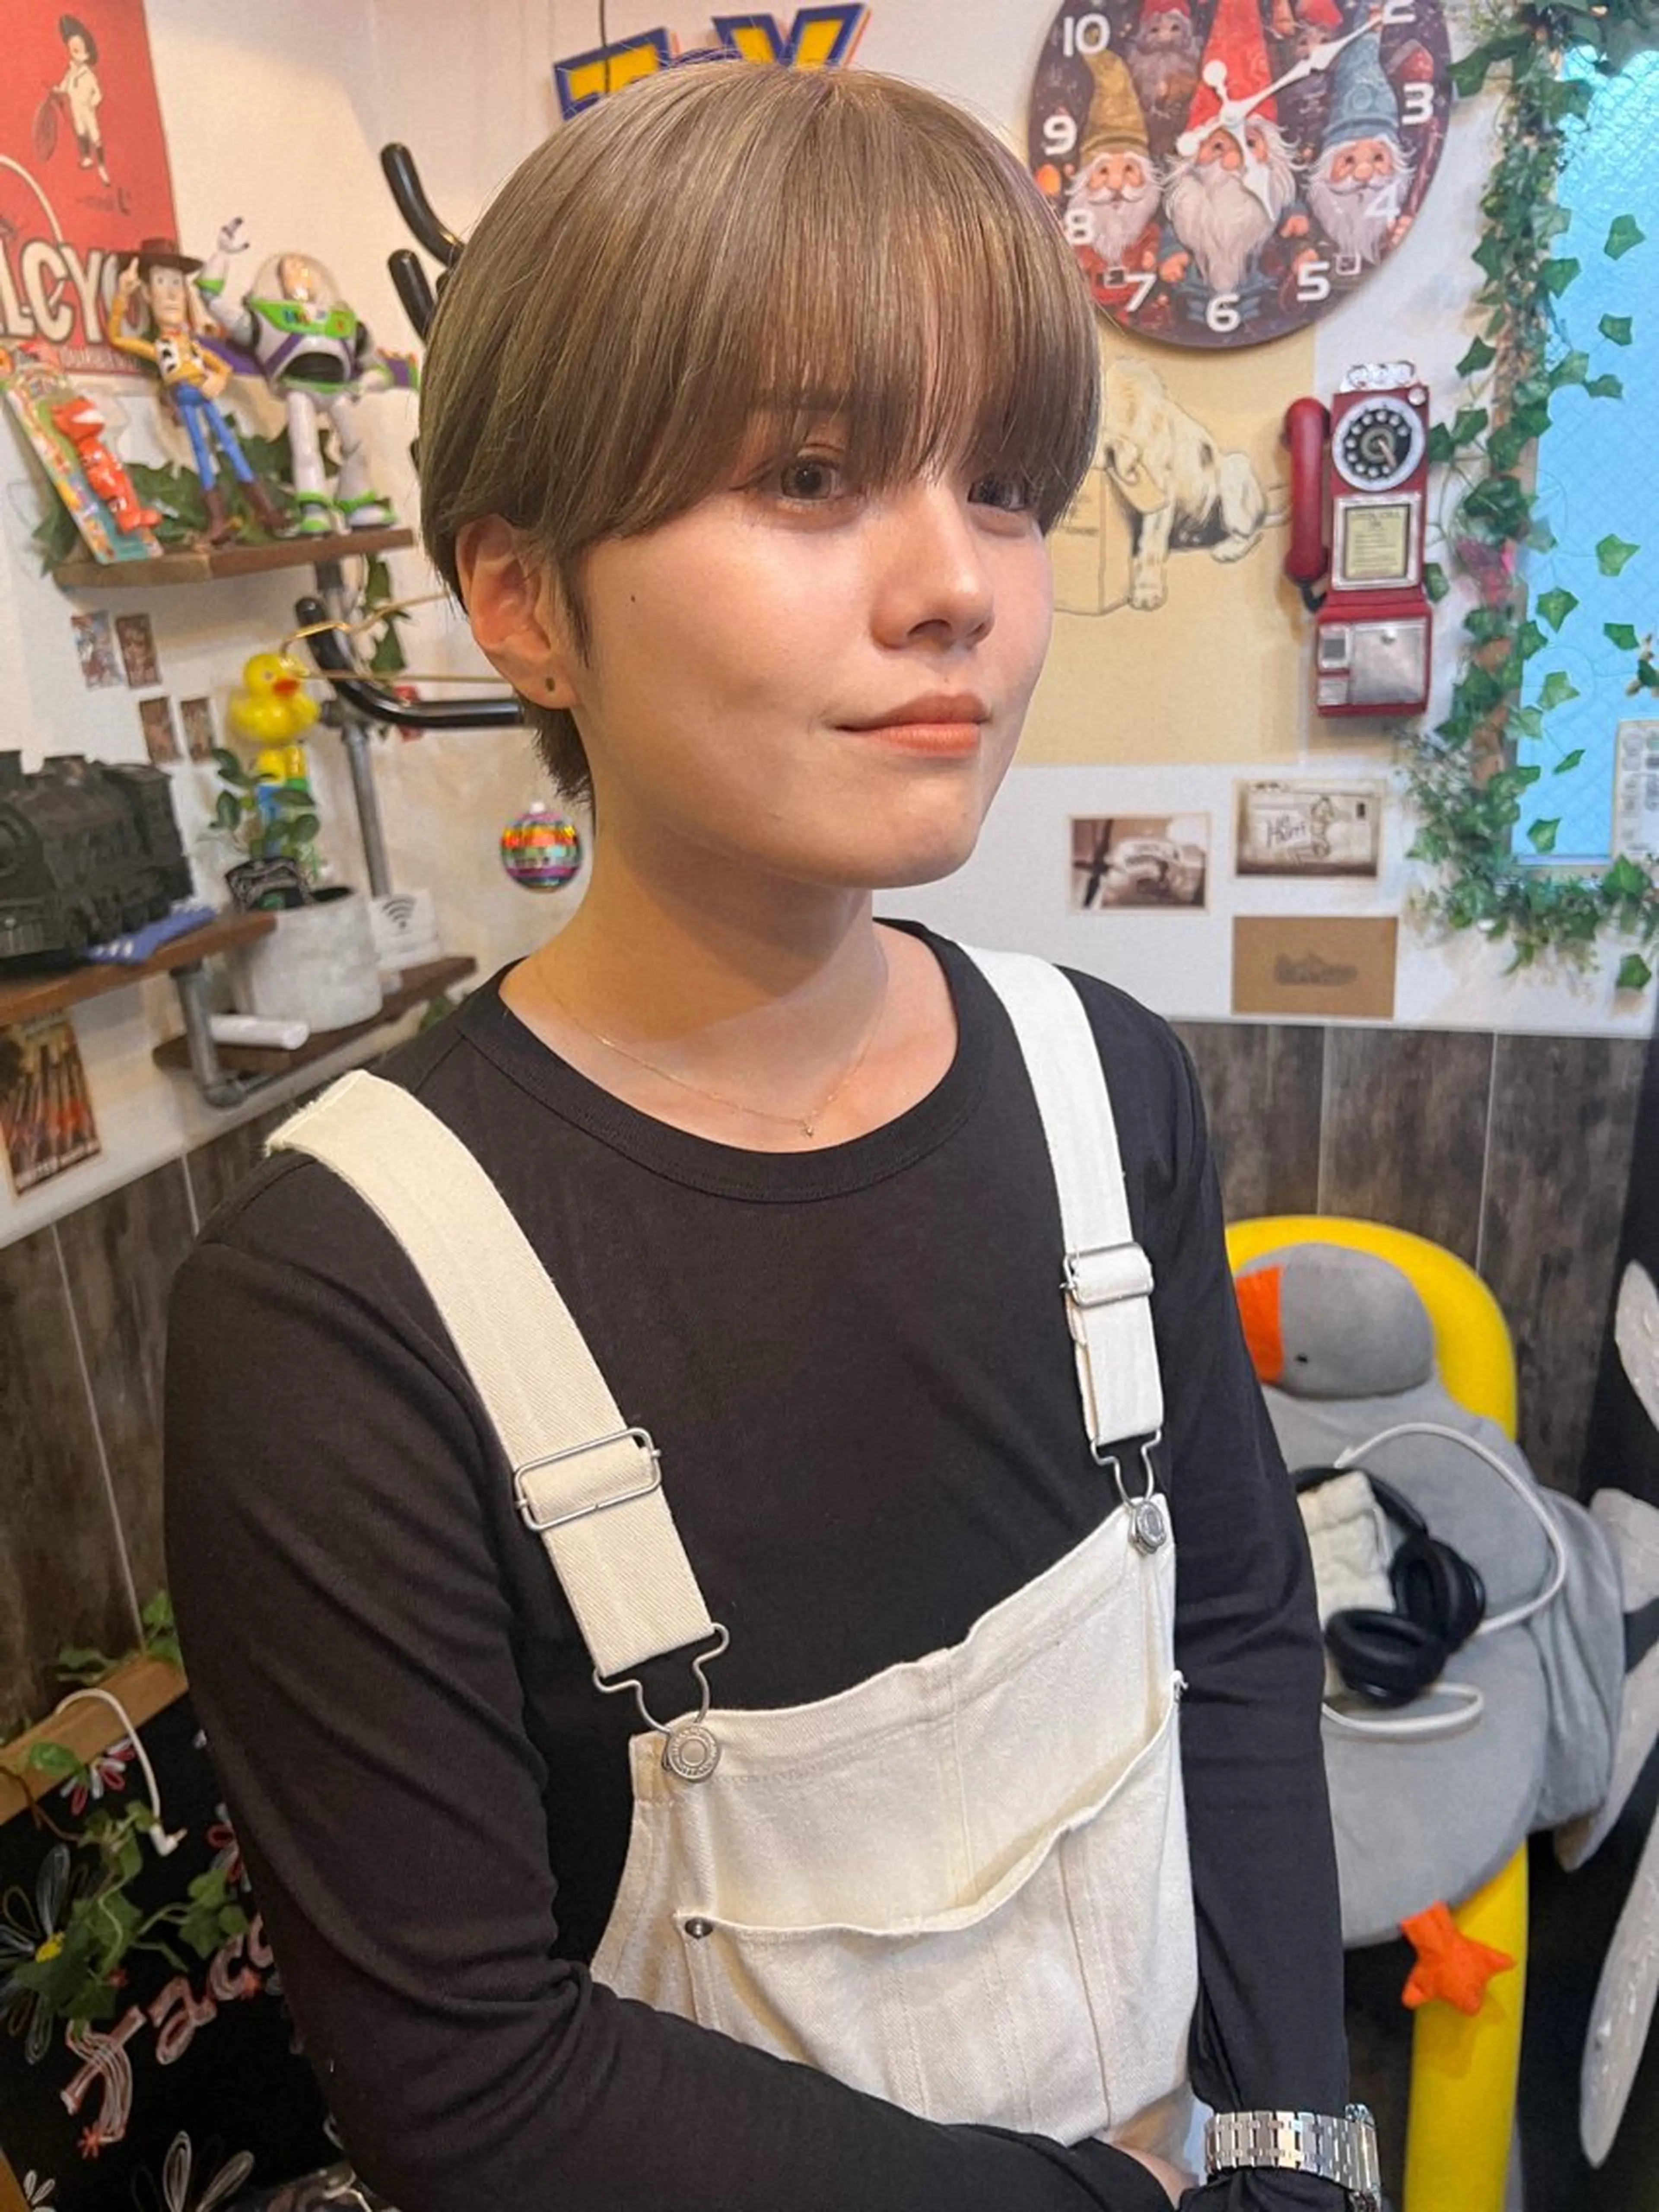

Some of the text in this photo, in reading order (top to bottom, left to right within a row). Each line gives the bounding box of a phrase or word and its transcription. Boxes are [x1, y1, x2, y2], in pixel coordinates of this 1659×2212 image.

[1064, 13, 1110, 57] 10
[1402, 82, 1434, 125] 3
[1043, 115, 1077, 155] 9
[1366, 184, 1401, 221] 4
[1065, 208, 1095, 245] 8
[1125, 274, 1157, 311] 7
[1297, 262, 1330, 301] 5
[1207, 294, 1240, 331] 6
